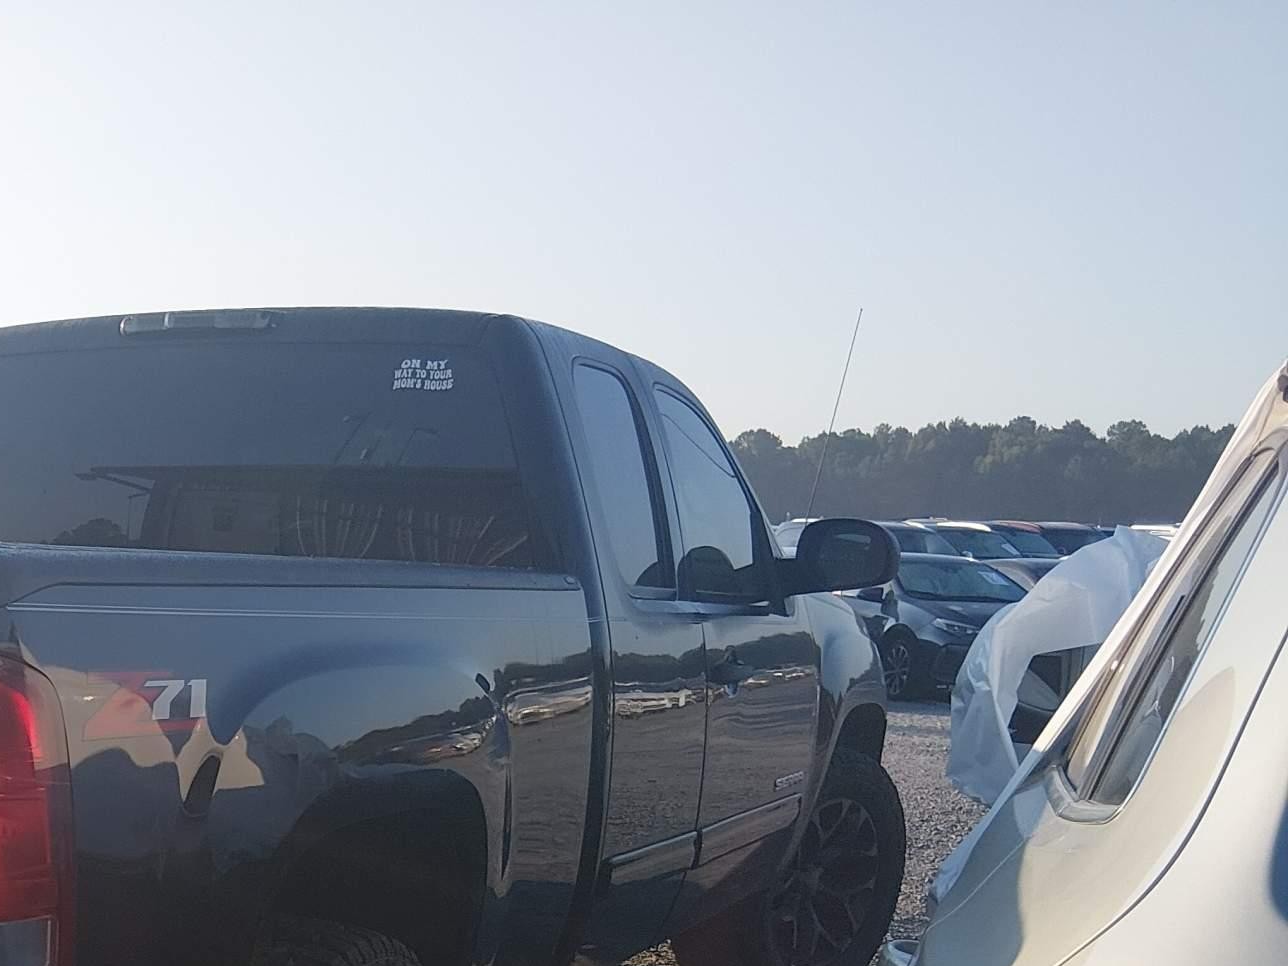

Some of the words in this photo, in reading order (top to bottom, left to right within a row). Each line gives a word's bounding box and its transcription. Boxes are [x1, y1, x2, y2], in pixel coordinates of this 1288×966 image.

[400, 359, 421, 369] ON
[425, 359, 448, 370] MY
[394, 368, 414, 379] WAY
[415, 369, 427, 378] TO
[429, 368, 453, 380] YOUR
[423, 378, 454, 391] HOUSE
